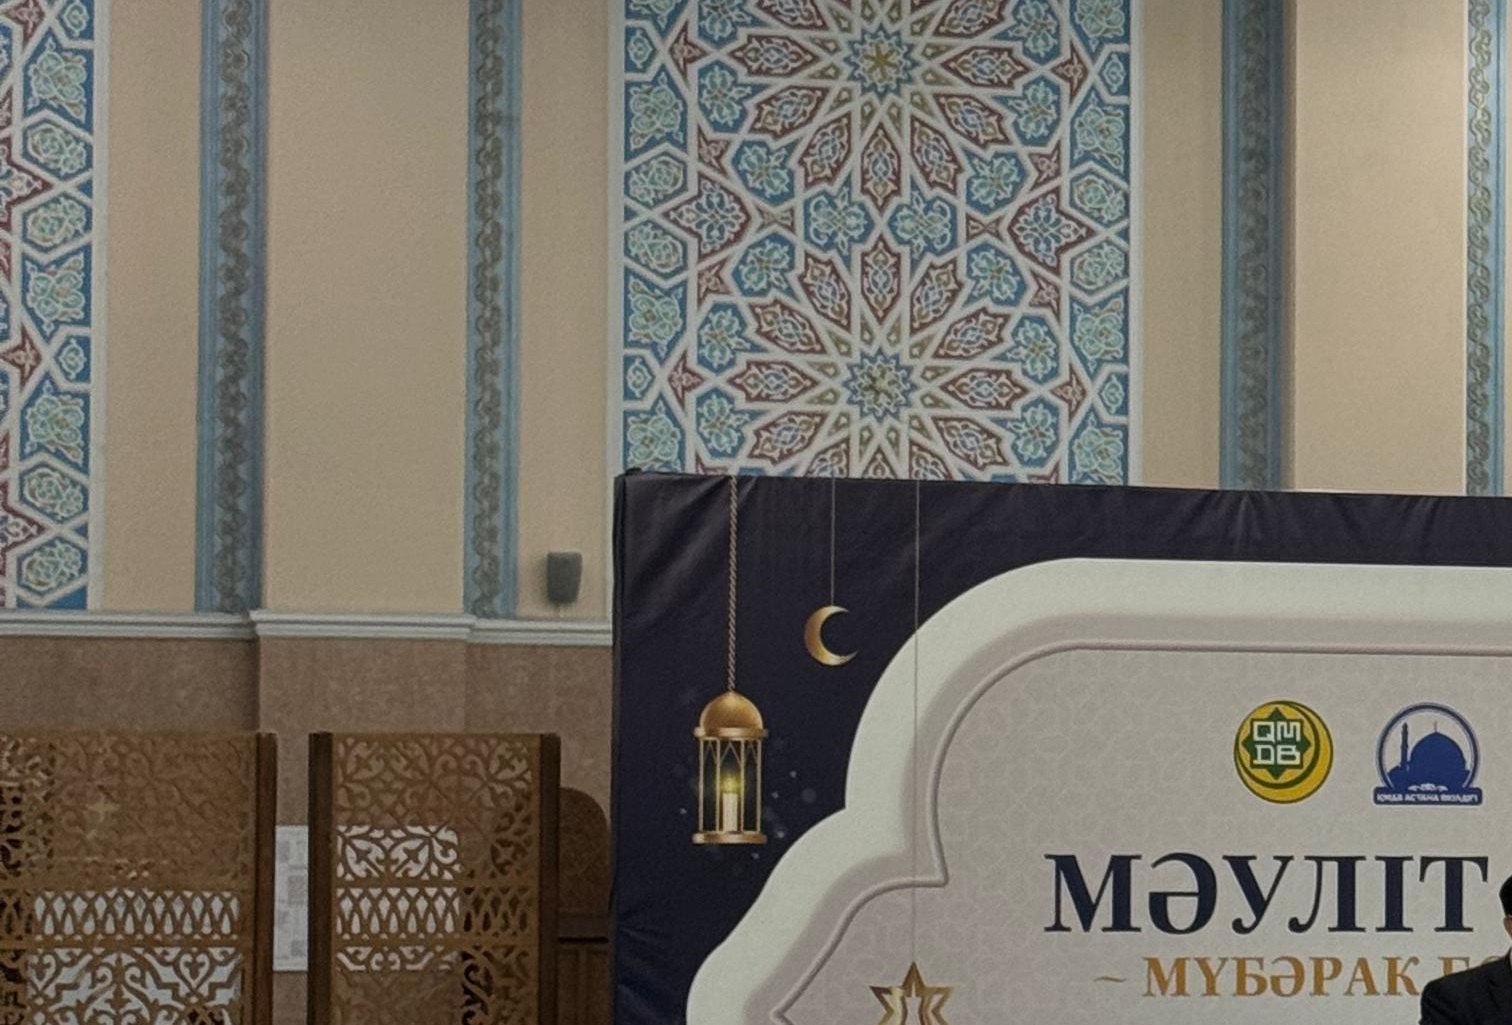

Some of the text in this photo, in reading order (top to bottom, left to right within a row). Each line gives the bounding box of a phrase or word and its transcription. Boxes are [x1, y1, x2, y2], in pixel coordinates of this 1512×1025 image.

[1253, 721, 1301, 742] QM
[1253, 745, 1301, 765] DB
[1043, 852, 1490, 935] МӘУЛІТ
[1142, 956, 1420, 997] МҮБӘРАК
